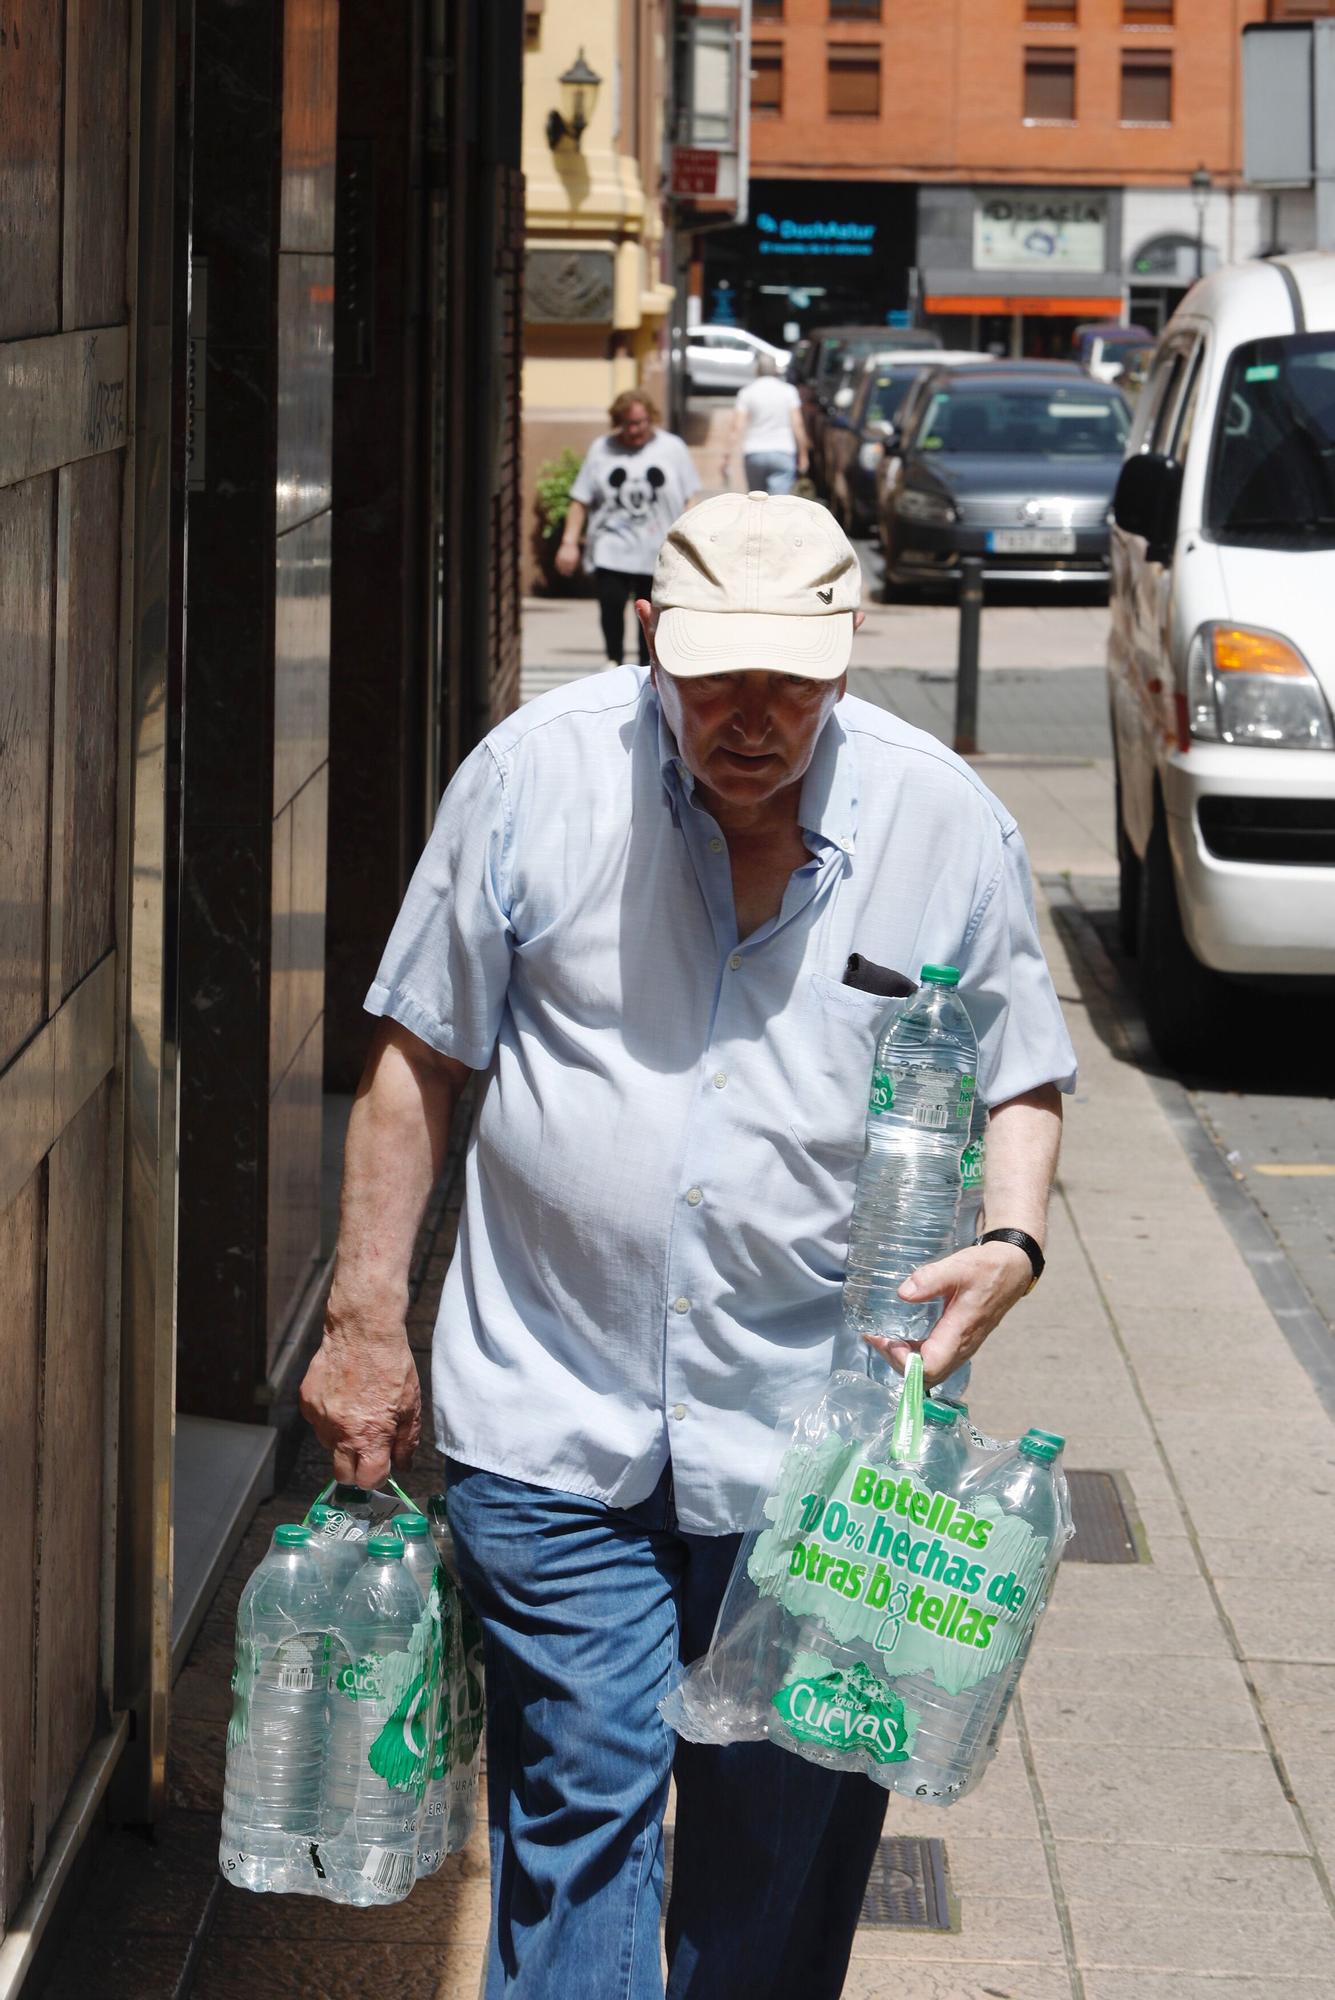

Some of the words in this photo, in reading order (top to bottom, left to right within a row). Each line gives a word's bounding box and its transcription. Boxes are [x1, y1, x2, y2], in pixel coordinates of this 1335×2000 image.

[850, 1466, 995, 1550] Botellas
[789, 1541, 866, 1599] otras
[798, 1493, 866, 1551] 100%
[868, 1516, 986, 1595] hechas
[986, 1571, 1026, 1614] de
[789, 1684, 898, 1754] Cuevas
[831, 1693, 854, 1710] Agua
[915, 1784, 927, 1795] 6
